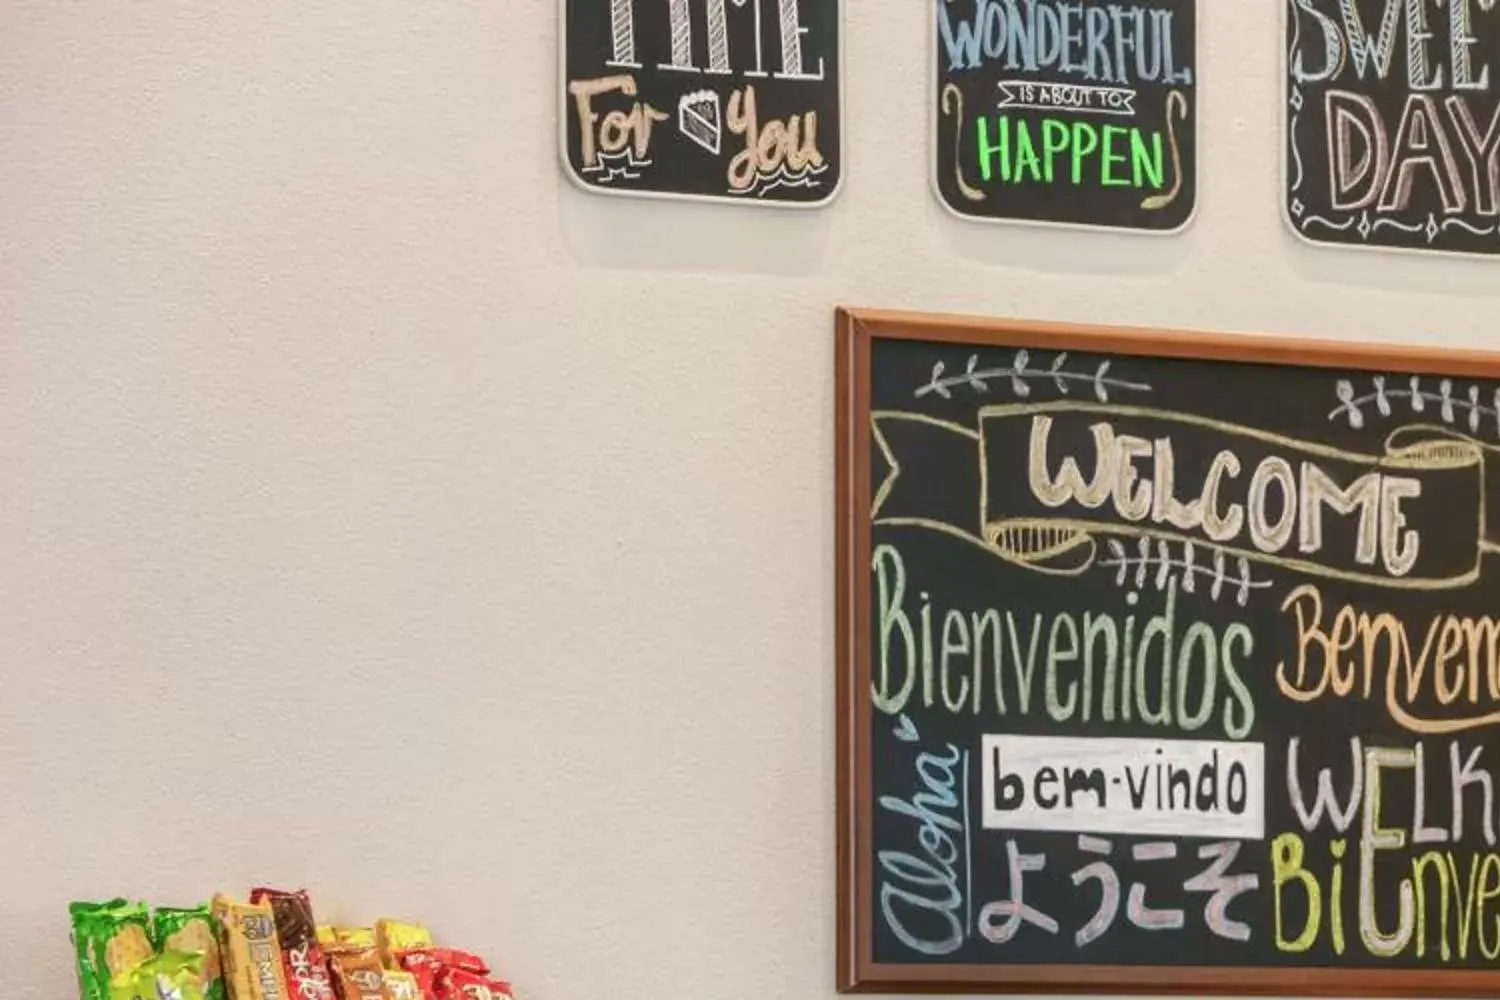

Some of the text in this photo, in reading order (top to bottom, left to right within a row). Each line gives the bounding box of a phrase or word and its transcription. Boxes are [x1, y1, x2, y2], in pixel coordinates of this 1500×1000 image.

[937, 0, 1192, 85] WONDERFUL
[569, 75, 670, 167] For
[1019, 85, 1122, 107] IS ABOUT TO
[976, 115, 1164, 189] HAPPEN
[1028, 414, 1422, 577] WELCOME
[870, 543, 1255, 740] Bienvenidos
[992, 745, 1248, 815] bem-vindo
[977, 834, 1260, 948] ようこそ
